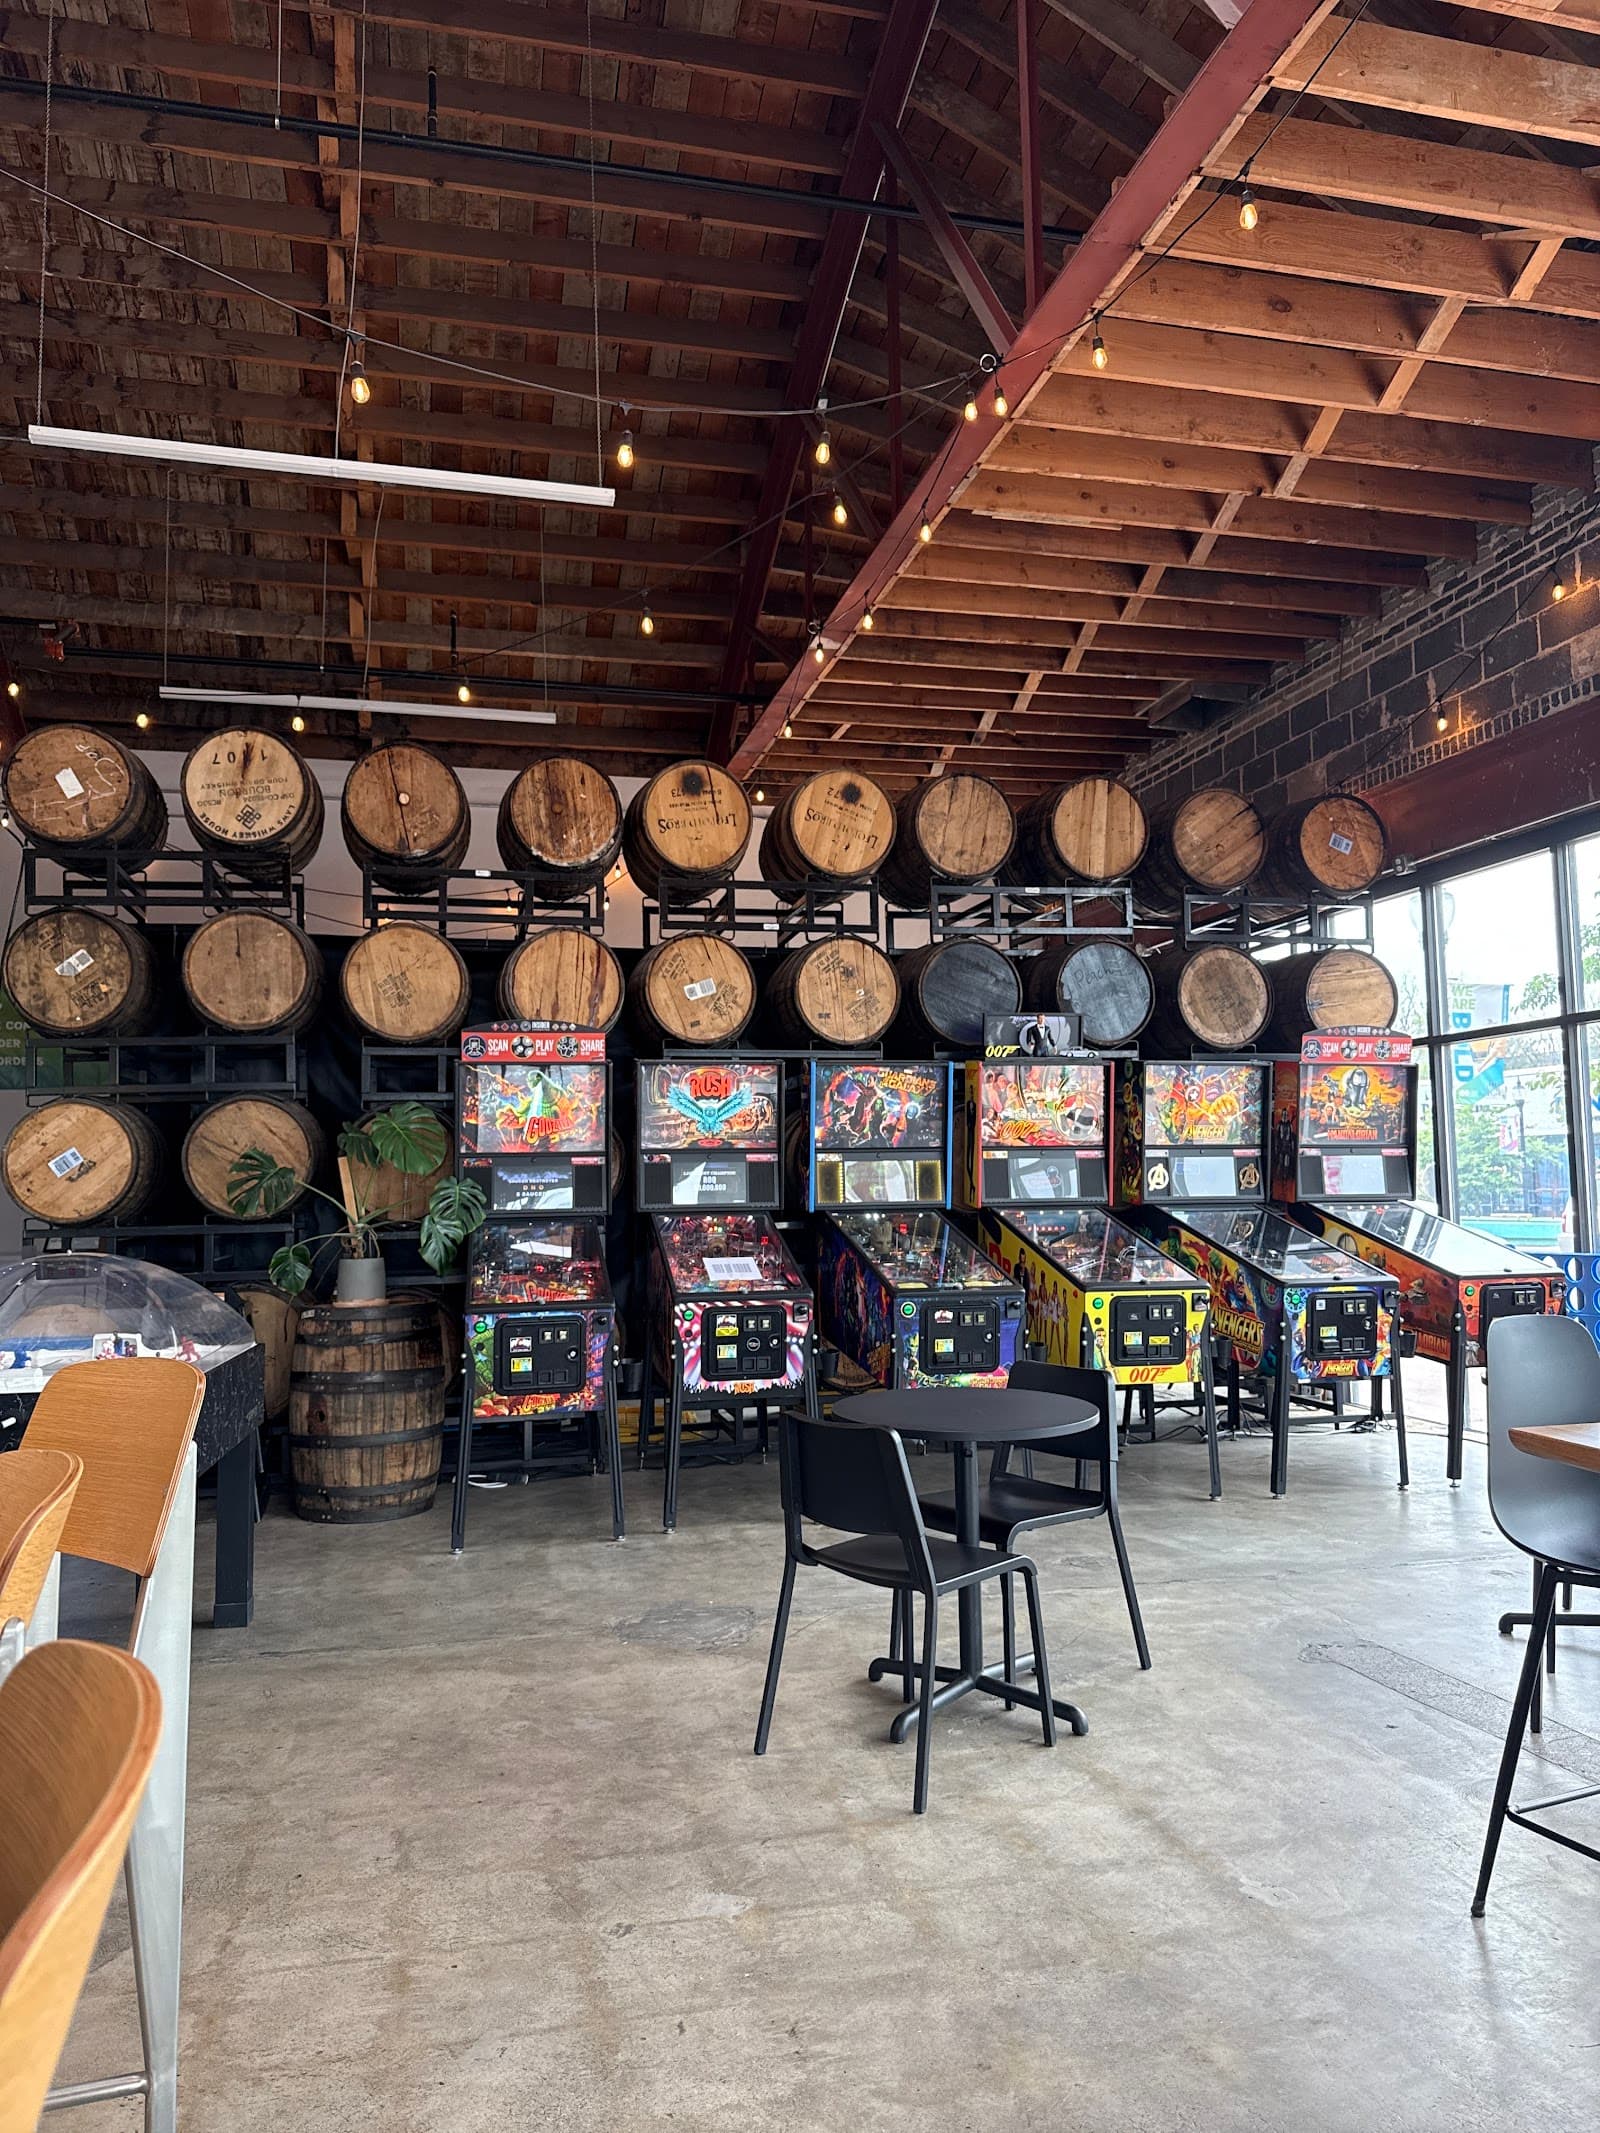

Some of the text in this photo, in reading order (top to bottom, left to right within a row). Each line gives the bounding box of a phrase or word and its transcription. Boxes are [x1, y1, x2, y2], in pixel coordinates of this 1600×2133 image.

[219, 785, 271, 798] BOURBON
[200, 804, 296, 839] LAWS WHISKEY HOUSE
[1451, 985, 1473, 997] WE
[1452, 999, 1476, 1010] ARE
[487, 1039, 605, 1052] SCAN PLAY SHARE
[986, 1045, 1019, 1057] 007
[1322, 1042, 1411, 1054] SCAN PLAY SHARE
[1452, 1012, 1473, 1082] BLD
[690, 1072, 733, 1098] RUSH
[1000, 1119, 1038, 1139] 007
[1129, 1367, 1172, 1383] 007
